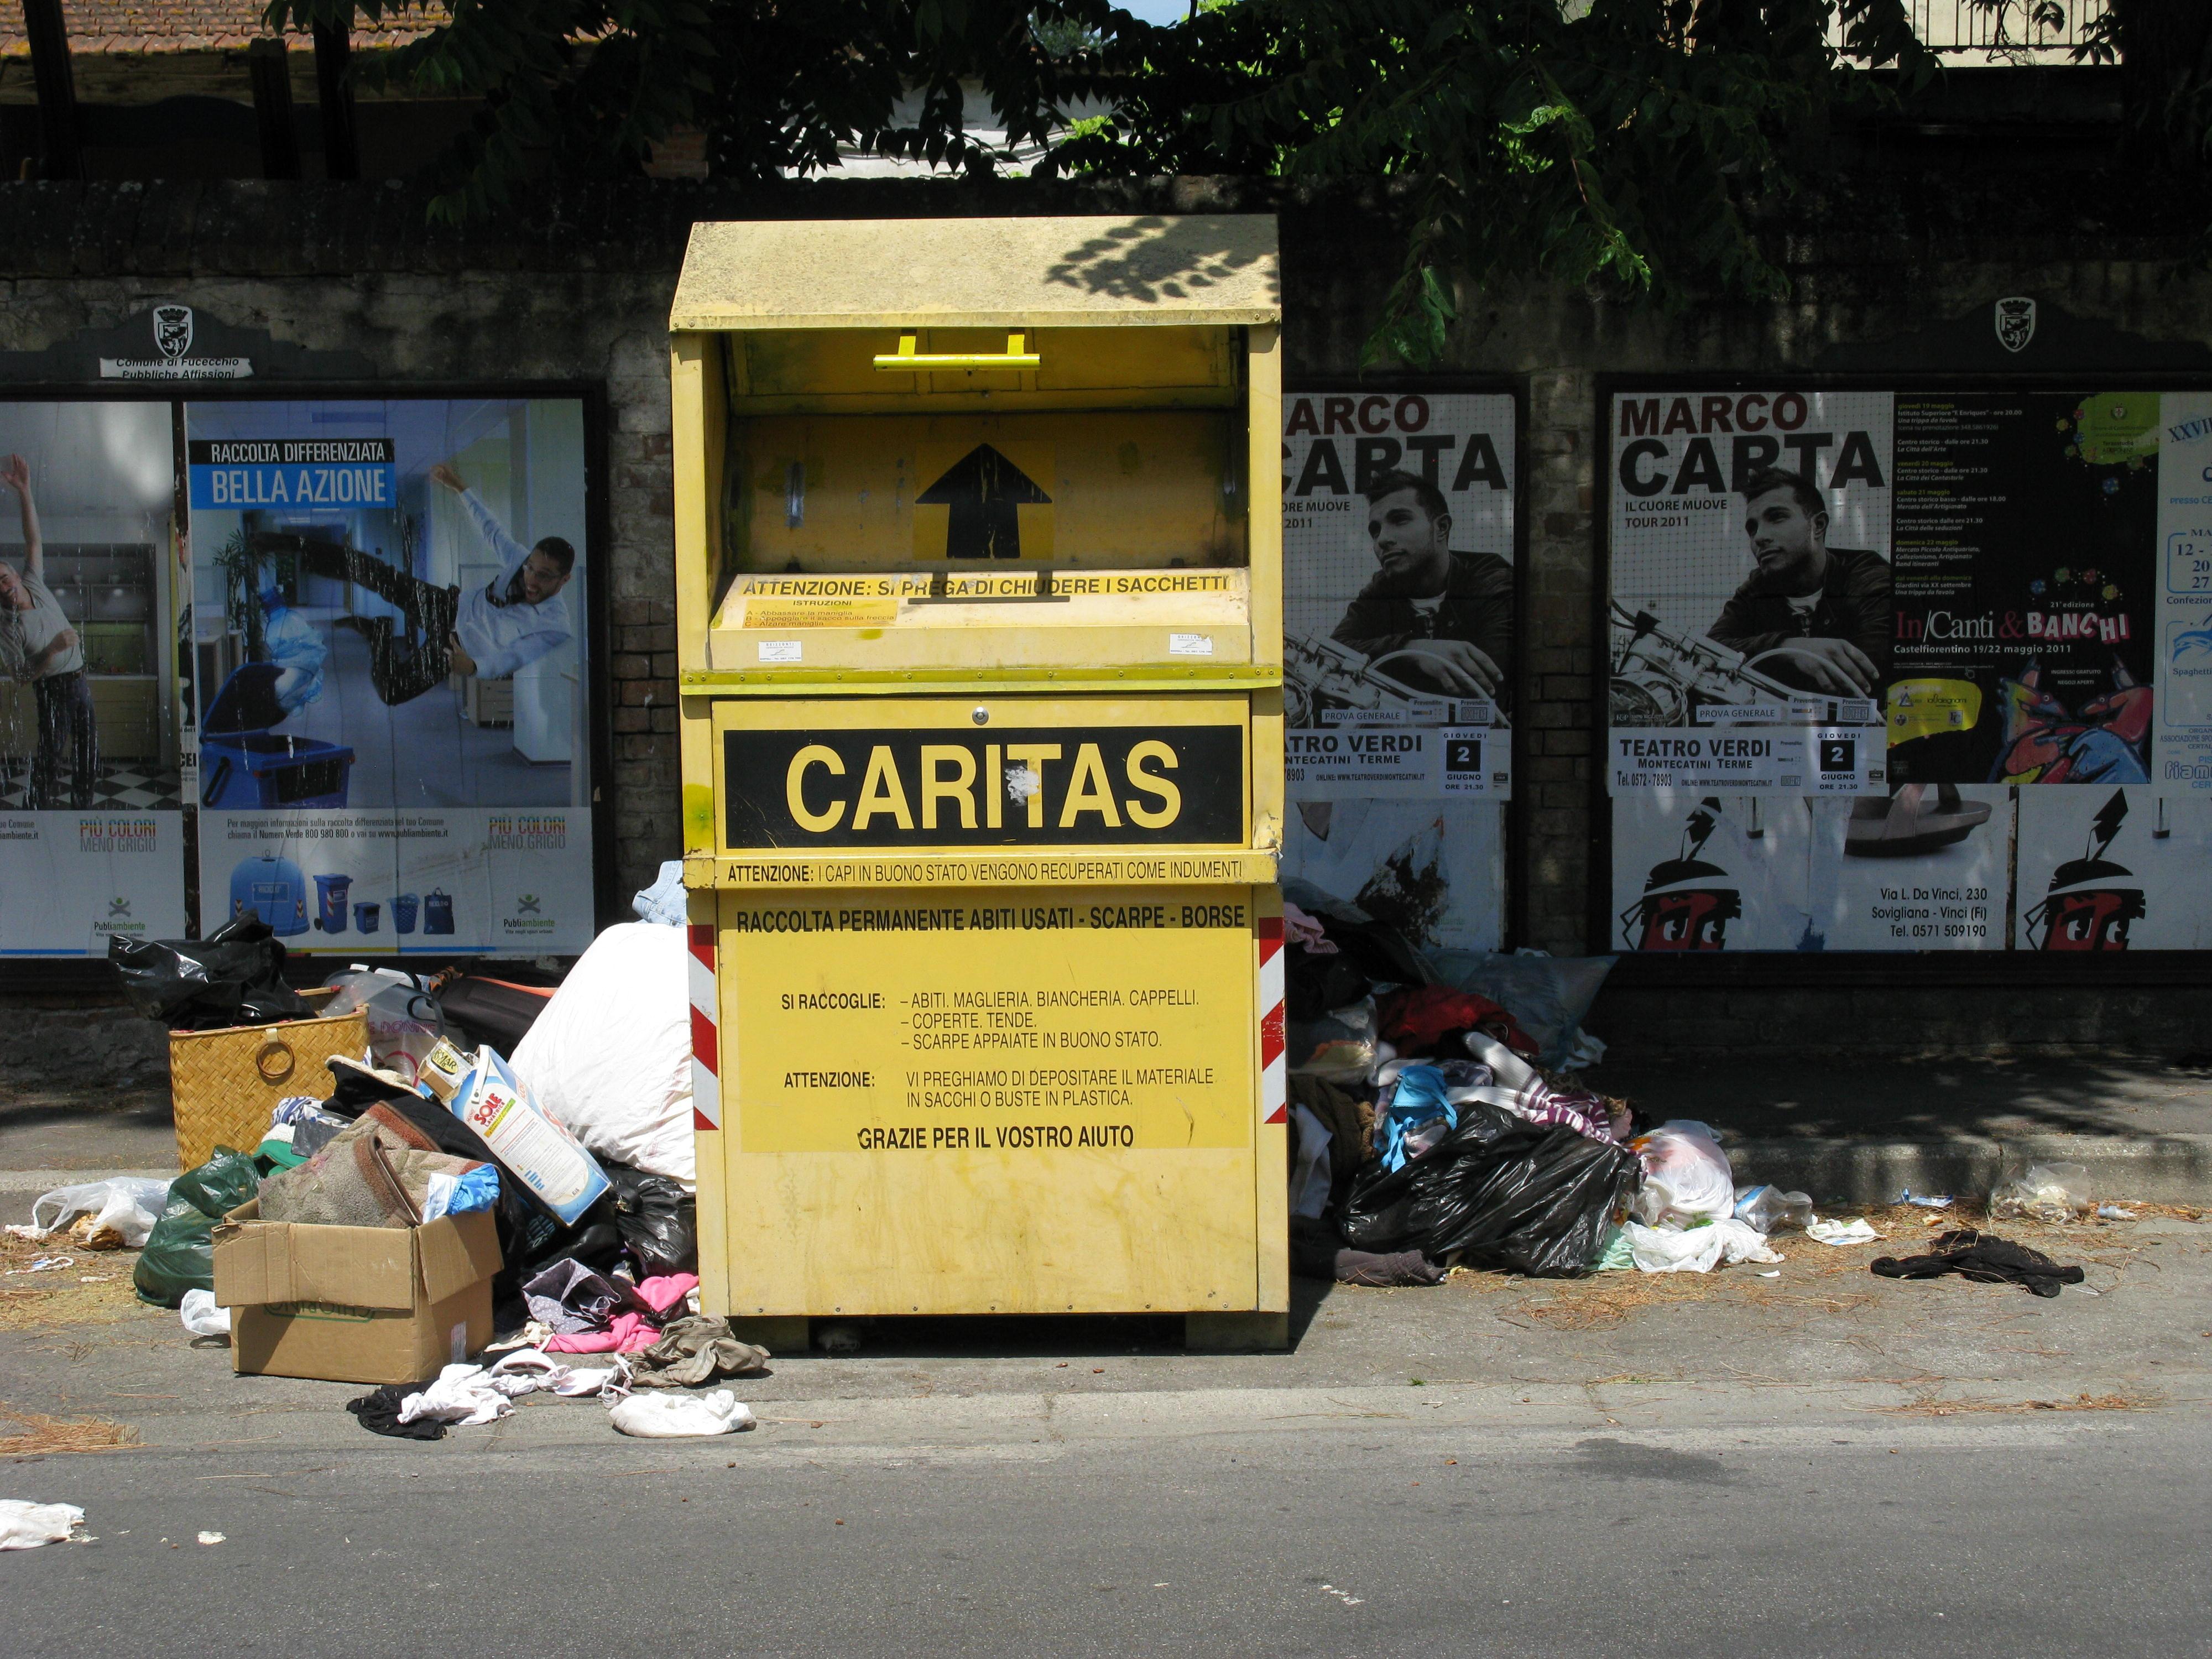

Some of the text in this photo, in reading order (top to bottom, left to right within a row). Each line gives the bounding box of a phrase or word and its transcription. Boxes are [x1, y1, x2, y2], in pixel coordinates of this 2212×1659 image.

[116, 358, 163, 367] Comune
[167, 358, 177, 367] di
[123, 369, 235, 379] Pubbliche Affissioni
[1621, 393, 1808, 437] MARCO
[211, 442, 385, 463] RACCOLTA DIFFERENZIATA
[1282, 433, 1509, 497] ARTA
[1620, 430, 1885, 497] CARTA
[212, 469, 385, 503] BELLA AZIONE
[1306, 502, 1350, 512] MUOVE
[1625, 499, 1728, 513] IL CUORE MUOVE
[1286, 518, 1312, 528] 2011
[1626, 517, 1689, 528] TOUR 2011
[2177, 544, 2194, 556] 12
[2192, 560, 2210, 572] 20
[743, 575, 1229, 596] ATTENZIONE: SI PREGA DI CHIUDERE SACCHETTI
[2192, 577, 2209, 589] 27
[1895, 610, 2130, 644] In/Canti & BANCHI
[1893, 645, 2072, 656] Castelfiorentino 19/22 maggio 2011
[1699, 709, 1775, 718] PROVA GENERALE
[1348, 735, 1422, 752] VERDI
[1620, 739, 1770, 757] TEATRO VERDI
[1358, 754, 1401, 764] TERME
[1457, 747, 1470, 762] 2
[1831, 747, 1844, 762] 2
[1637, 758, 1752, 769] MONTECATINI TERME
[786, 740, 1181, 832] CARITAS
[1617, 771, 1672, 786] Tel. 0572 78903
[80, 816, 155, 837] PIÙ COLORI
[489, 813, 566, 834] PIÙ COLORI
[259, 828, 448, 839] Numero Verde 800 980 800 www.publiambiente.it
[80, 837, 156, 852] MENO GRIGIO
[489, 834, 566, 849] MENO GRIGIO
[728, 860, 1242, 882] ATTENZIONE: CAPI IN BUONO STATO VENGONO RECUPERATI COME INDUMENTI
[1880, 888, 1987, 902] Via L. Da Vinci, 230
[737, 905, 1245, 933] RACCOLTA PERMANENTE ABITI USATI SCARPE BORSE
[1871, 906, 1987, 921] Sovigliana Vinci (Fi)
[94, 921, 145, 930] Publiambiente
[503, 919, 555, 927] Publiambiente
[1890, 925, 1986, 937] Tel. 0571 509190
[781, 989, 1199, 1010] SI RACCOGLIE: ABITI. MAGLIERIA. BIANCHERIA. CAPPELLI.
[912, 1012, 1037, 1029] COPERTE. TENDE.
[913, 1031, 1162, 1050] SCARPE APPAIATE IN BUONO STATO.
[784, 1068, 1214, 1088] ATTENZIONE: VI PREGHIAMO DI DEPOSITARE IL MATERIALE
[907, 1089, 1133, 1108] IN SACCHI BUSTE IN PLASTICA.
[474, 1093, 503, 1125] SOLE
[484, 1102, 505, 1127] LAVATRICE
[858, 1125, 1134, 1150] GRAZIE PER IL VOSTRO AIUTO
